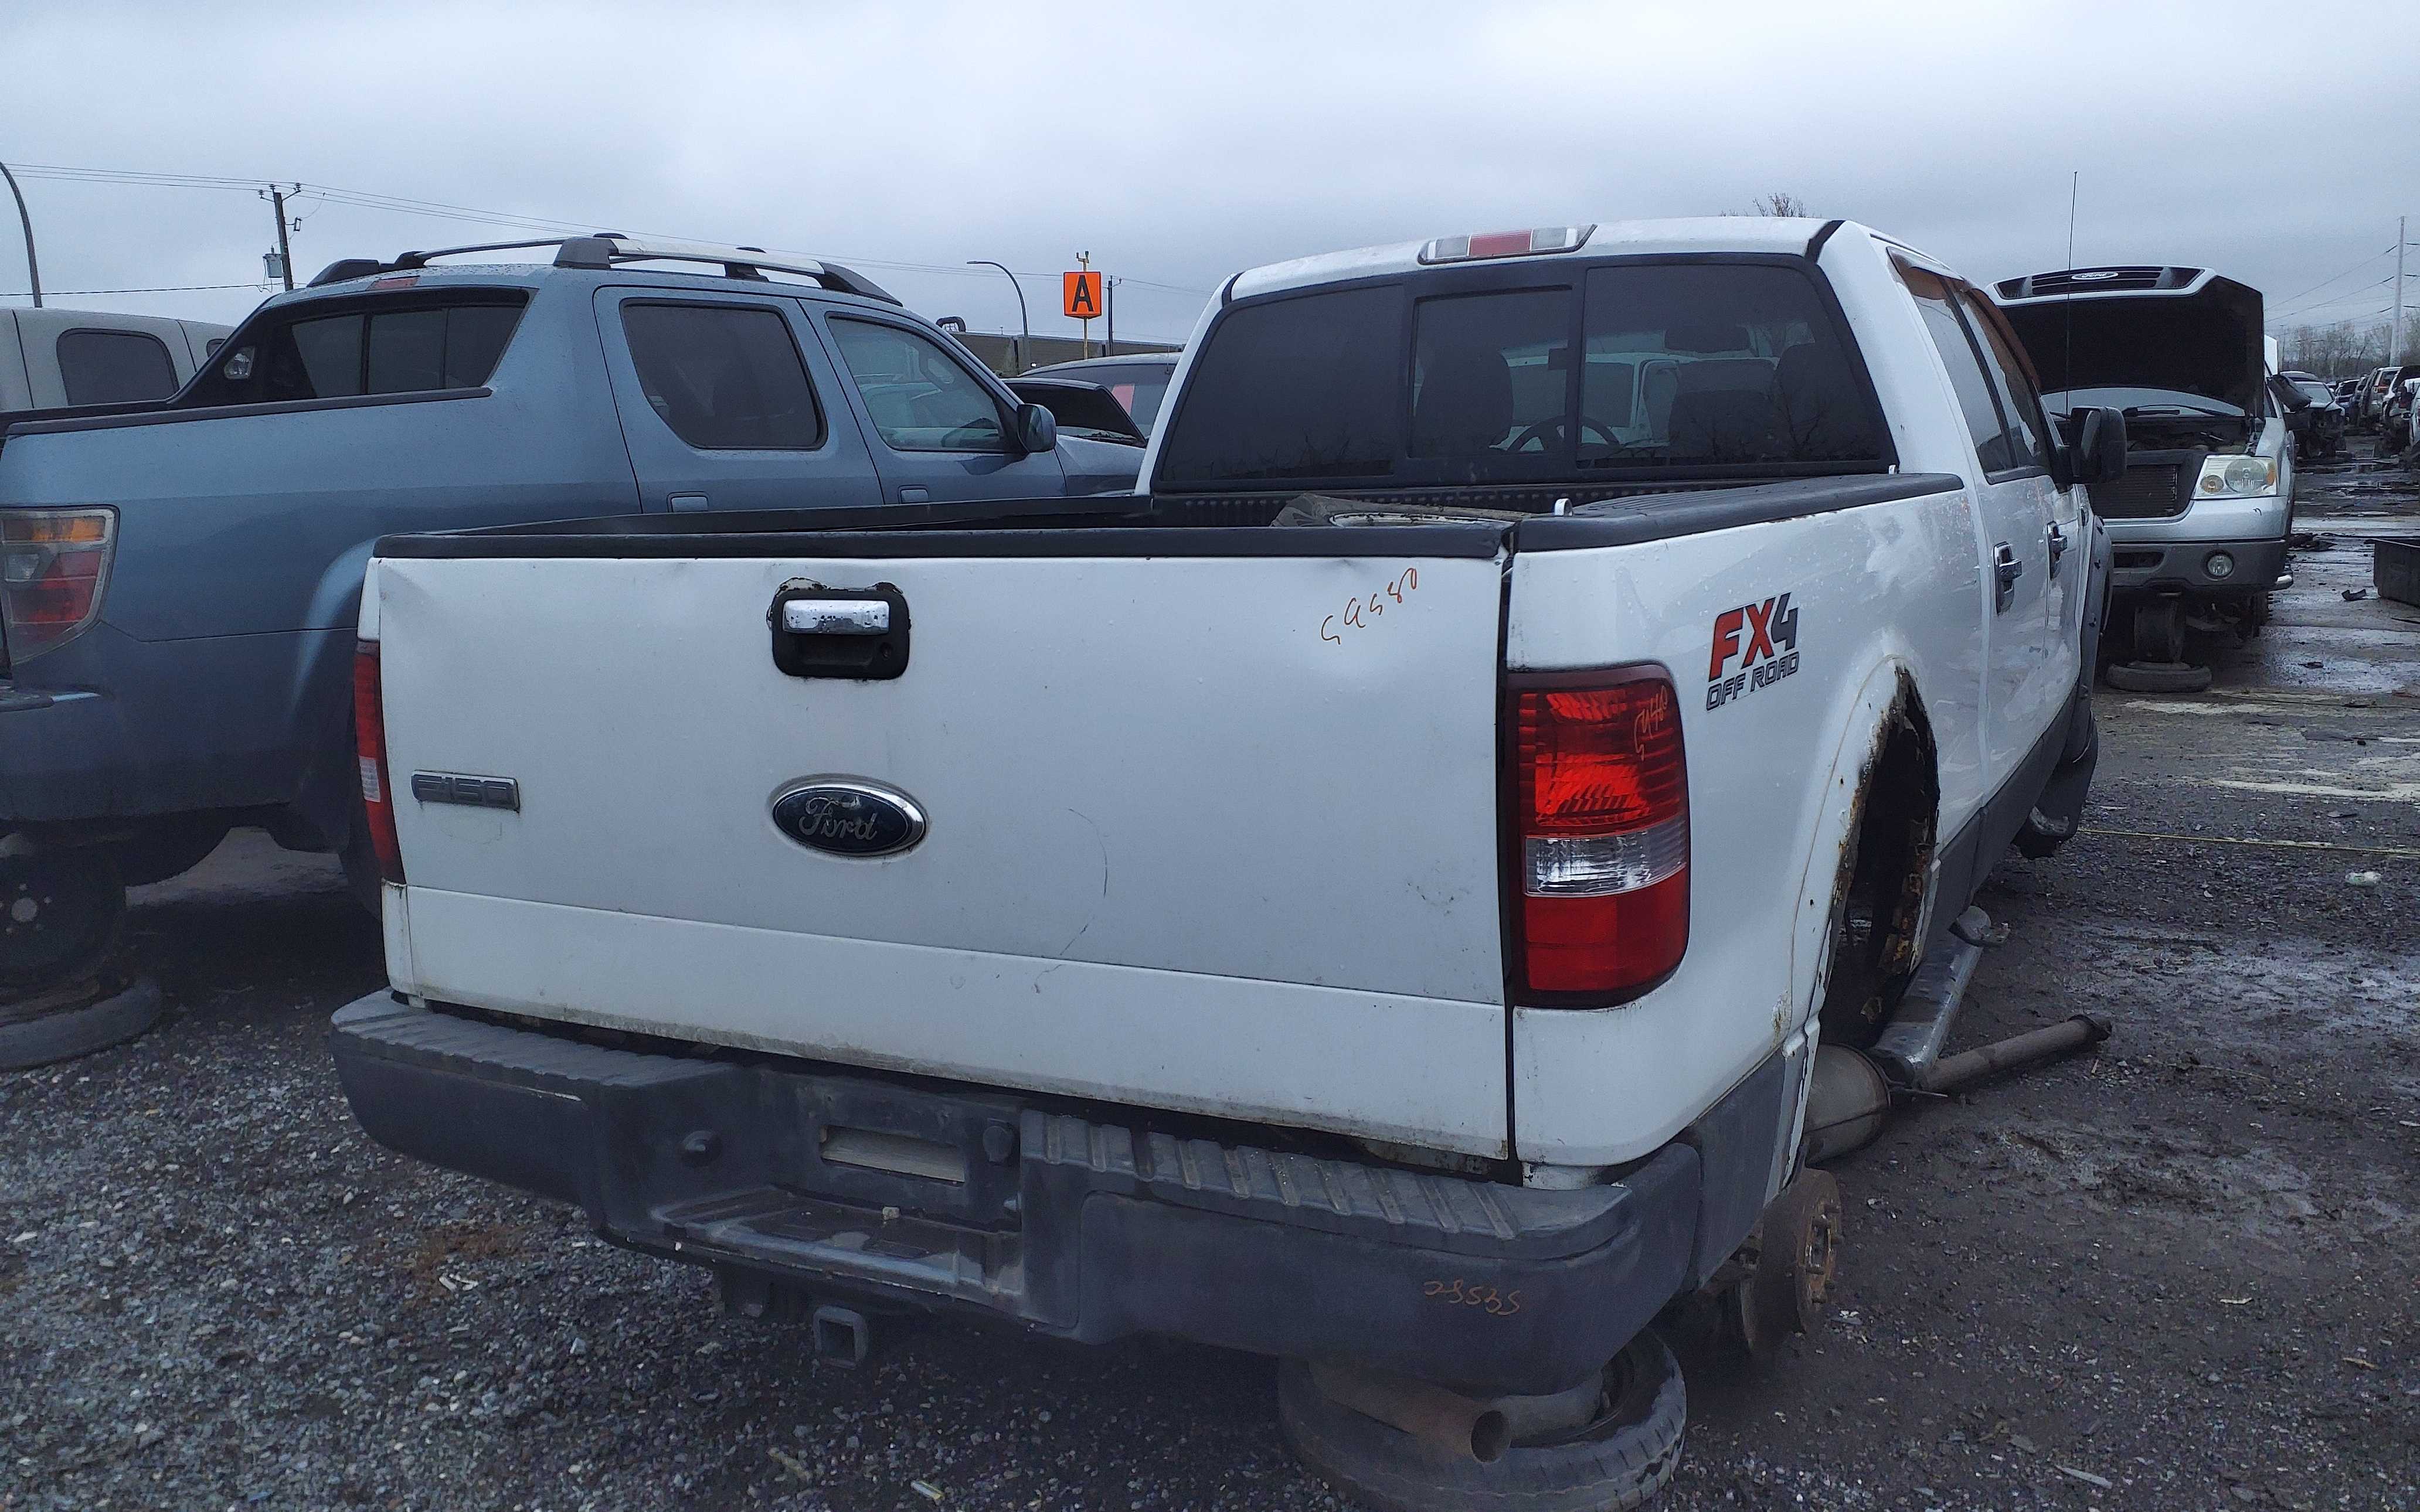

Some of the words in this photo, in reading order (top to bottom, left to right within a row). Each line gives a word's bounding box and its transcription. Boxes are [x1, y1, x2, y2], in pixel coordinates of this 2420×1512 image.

[1072, 275, 1095, 312] A
[1708, 592, 1799, 682] FX4
[1706, 673, 1746, 711] OFF
[1751, 652, 1799, 693] ROAD
[798, 796, 878, 840] Ford
